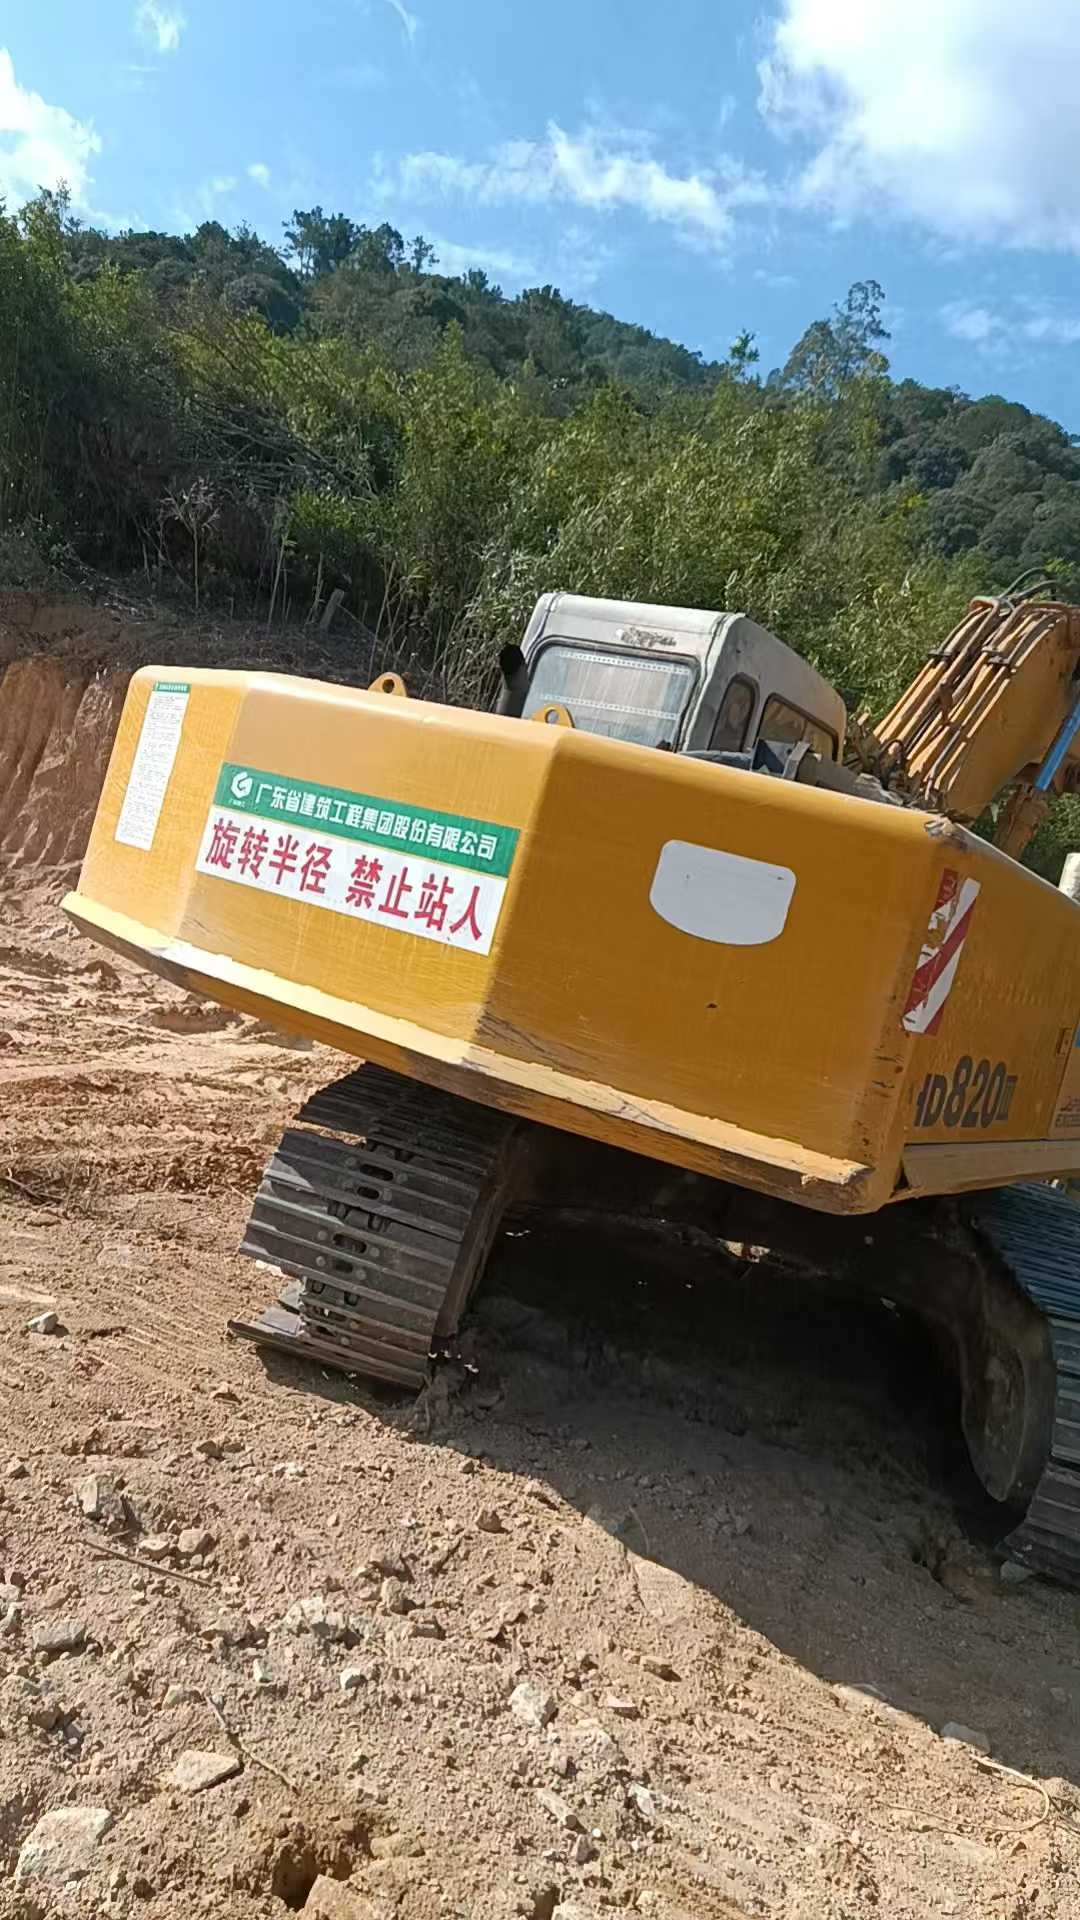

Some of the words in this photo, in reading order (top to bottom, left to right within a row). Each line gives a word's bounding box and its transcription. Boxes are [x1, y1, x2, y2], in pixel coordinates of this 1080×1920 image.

[254, 783, 499, 861] 广东省建筑工程集团股份有限公司
[205, 818, 333, 895] 旋转半径
[345, 854, 483, 940] 禁止站人
